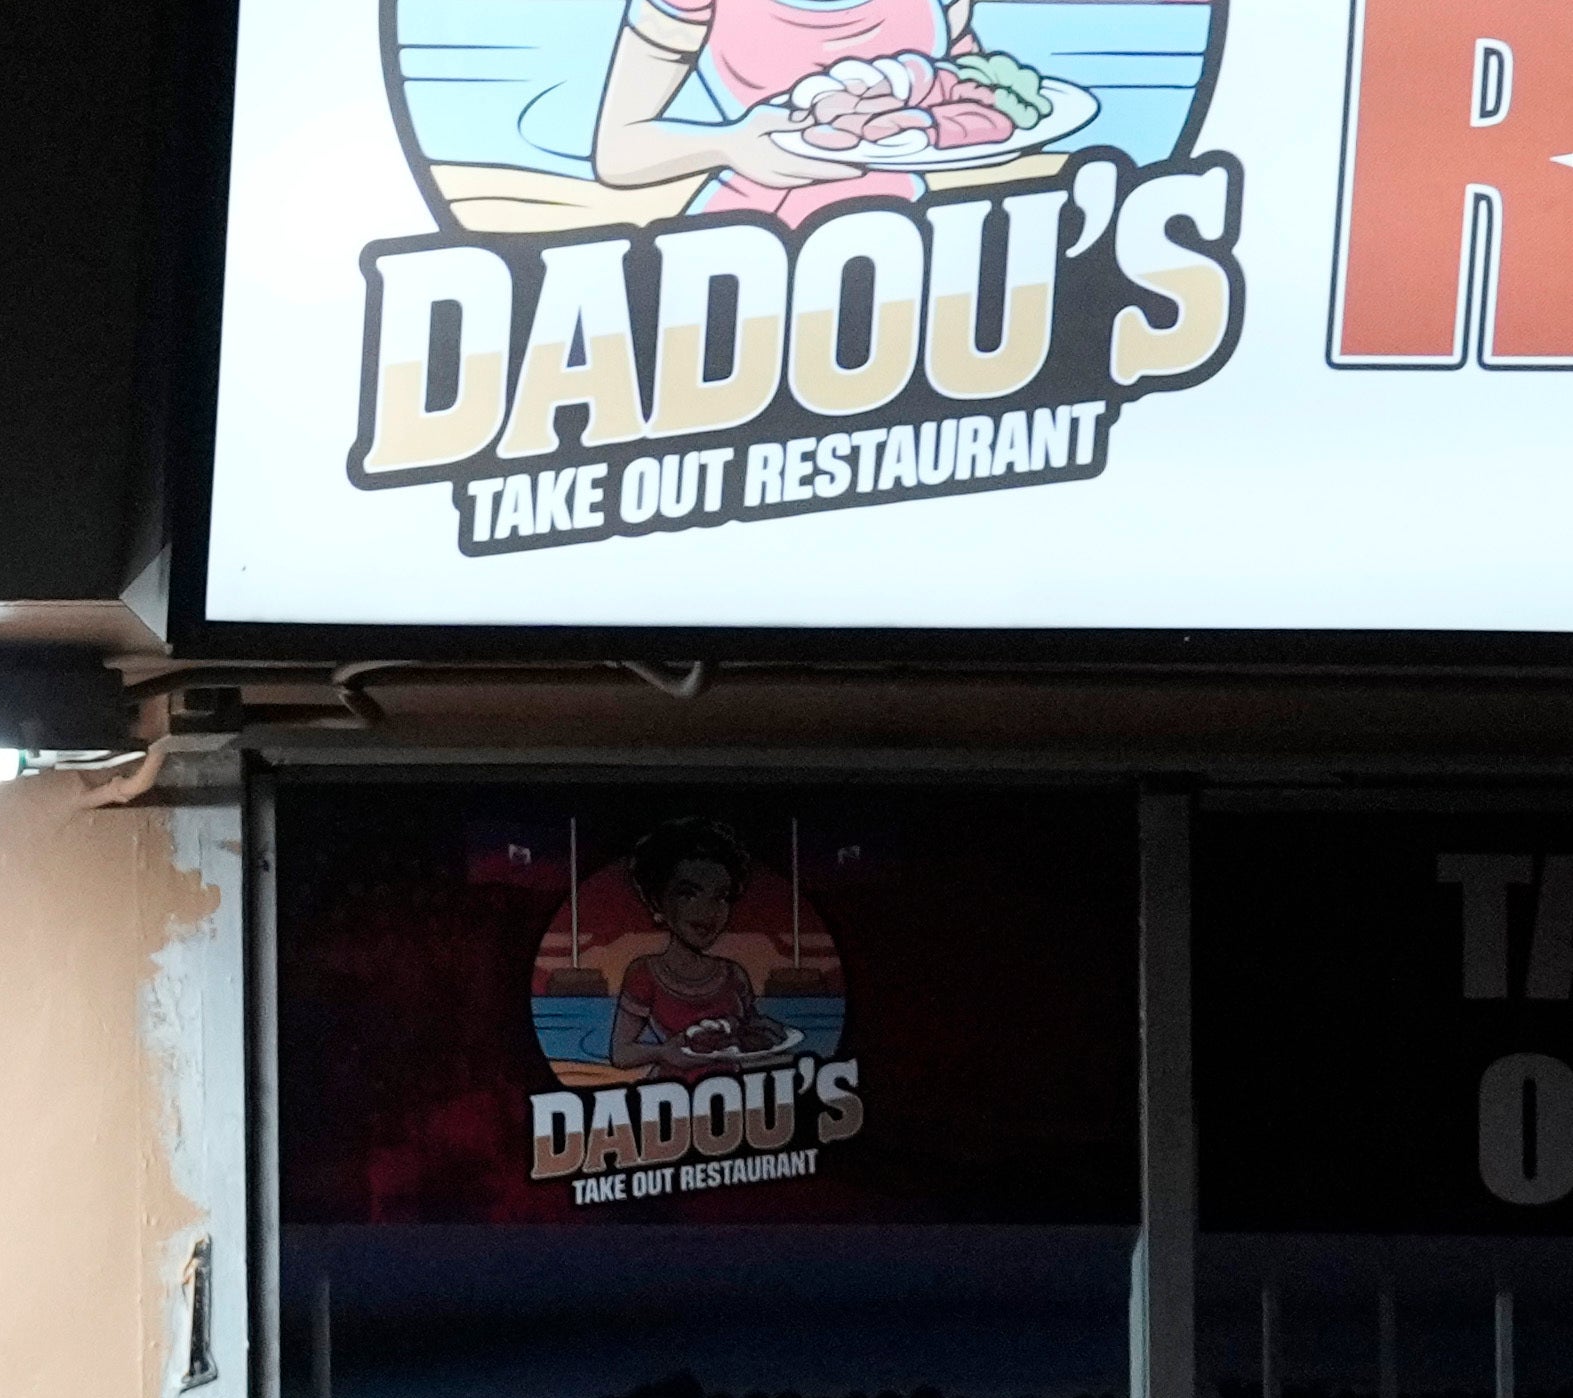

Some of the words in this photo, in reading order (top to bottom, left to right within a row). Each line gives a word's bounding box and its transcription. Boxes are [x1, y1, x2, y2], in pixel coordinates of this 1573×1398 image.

[363, 160, 1234, 473] DADOU'S
[468, 466, 604, 542] TAKE
[619, 446, 734, 524] OUT
[744, 400, 1107, 509] RESTAURANT
[530, 1058, 864, 1178] DADOU'S
[571, 1175, 626, 1204] TAKE
[631, 1166, 674, 1197] OUT
[681, 1148, 818, 1190] RESTAURANT
